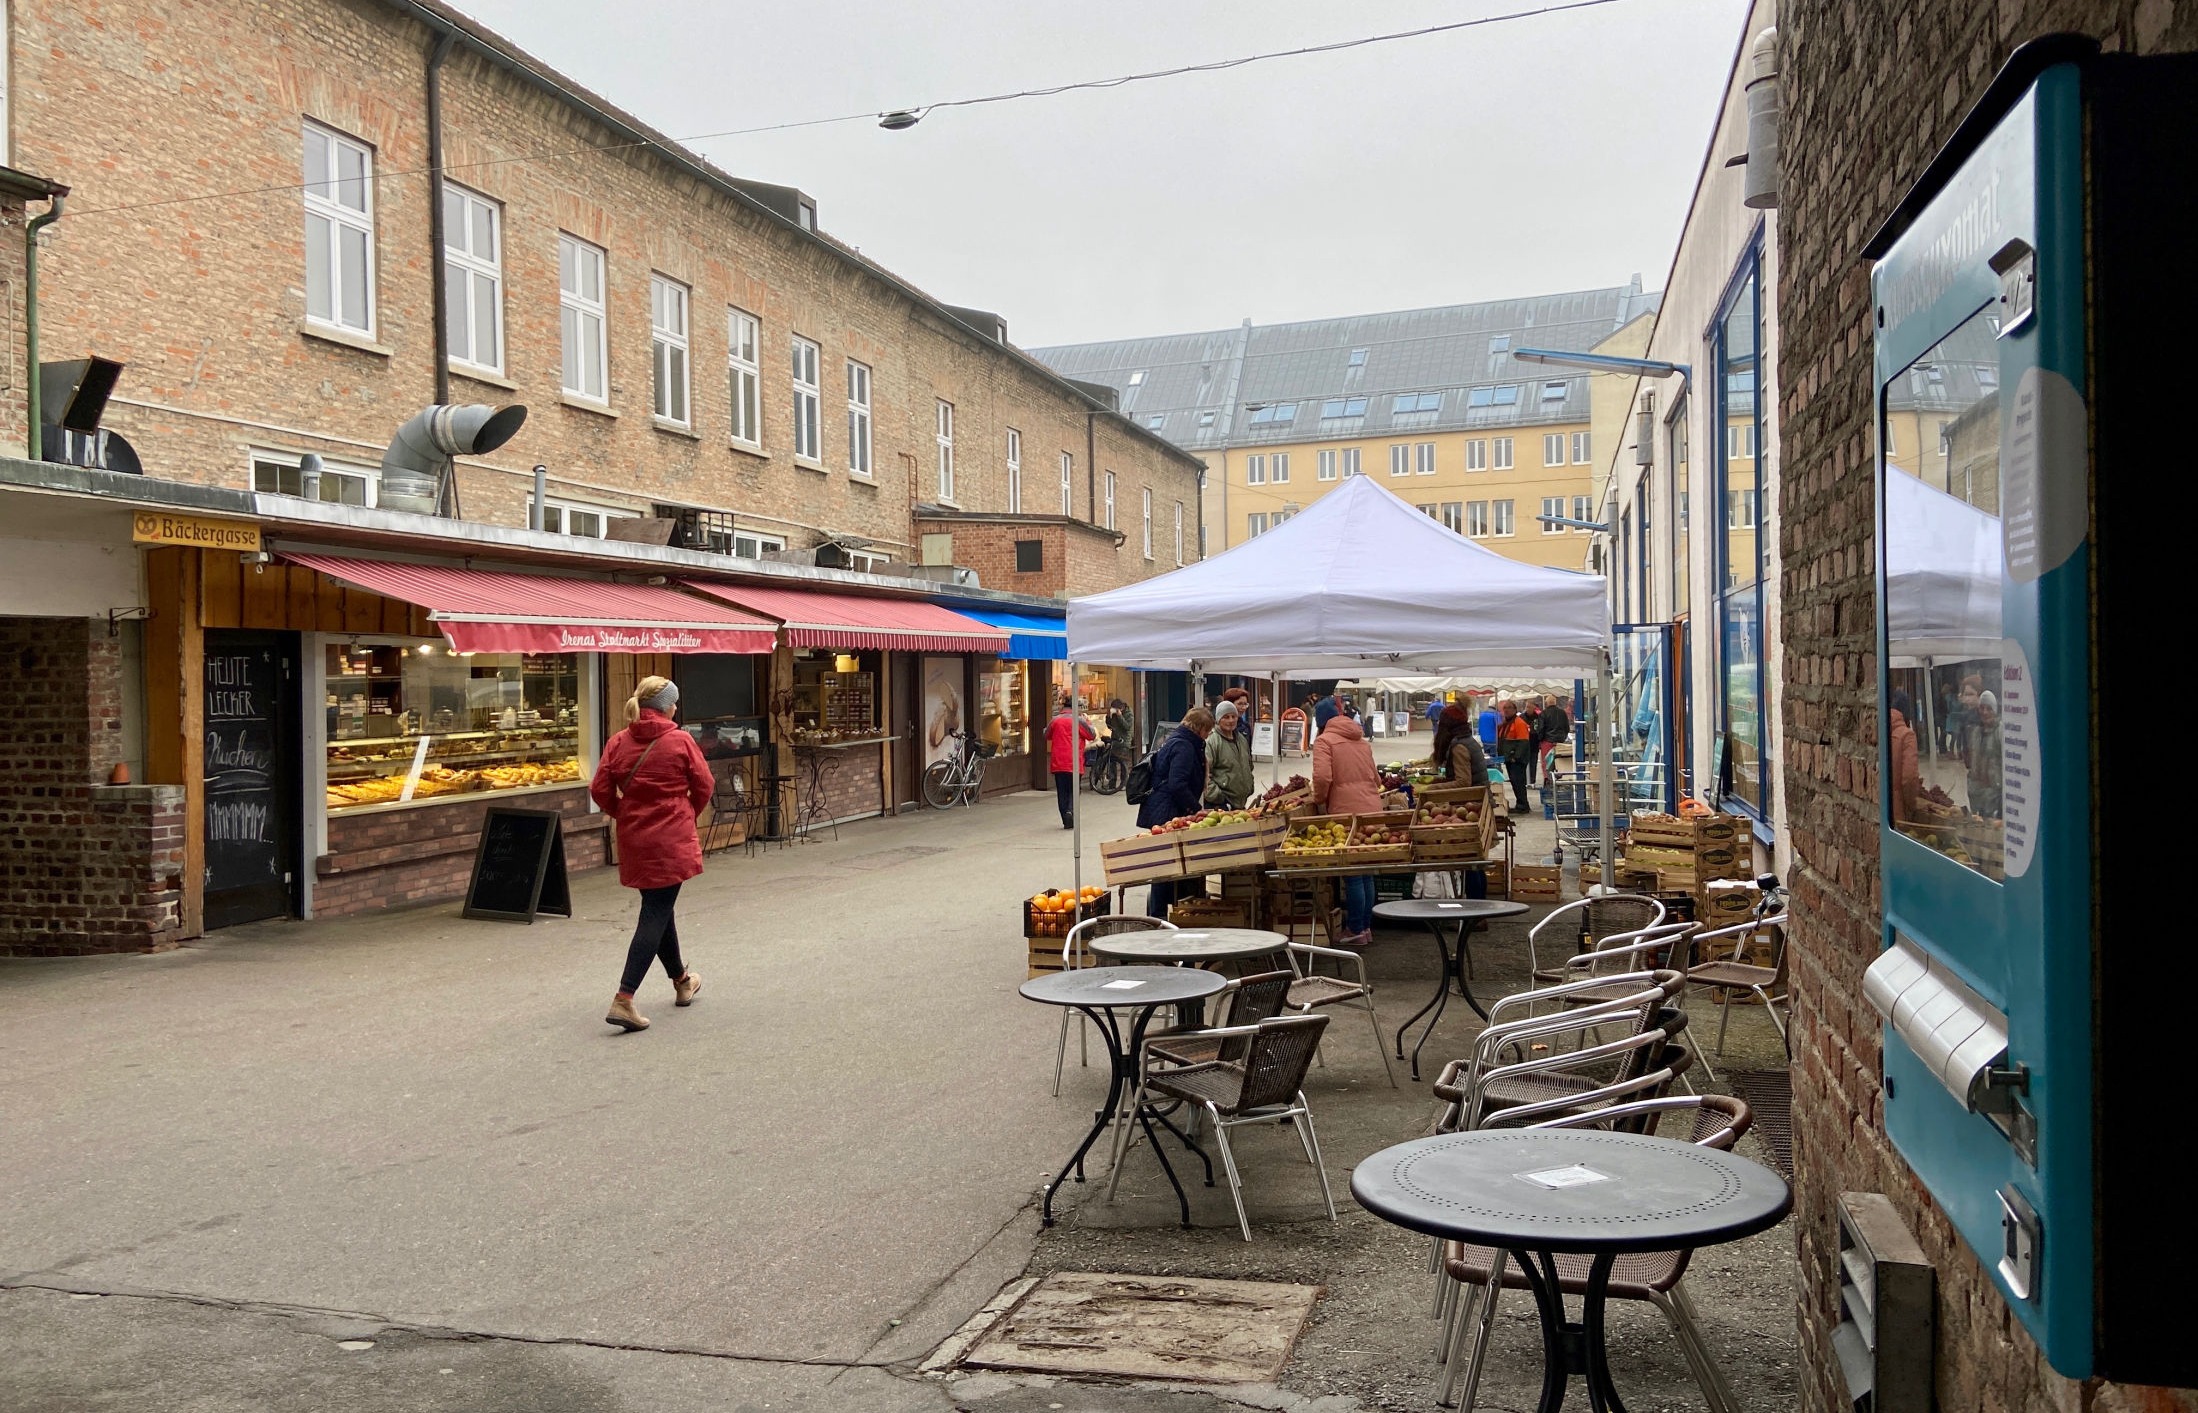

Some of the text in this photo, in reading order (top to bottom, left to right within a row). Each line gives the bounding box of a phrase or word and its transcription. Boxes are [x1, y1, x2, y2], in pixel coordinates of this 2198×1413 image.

[162, 518, 256, 546] Bäckergasse
[560, 629, 701, 650] Irenas Stadtmarkt Spezialitäten
[208, 656, 252, 685] HEUTE
[210, 691, 255, 716] LECKER
[207, 729, 268, 769] Kuchen
